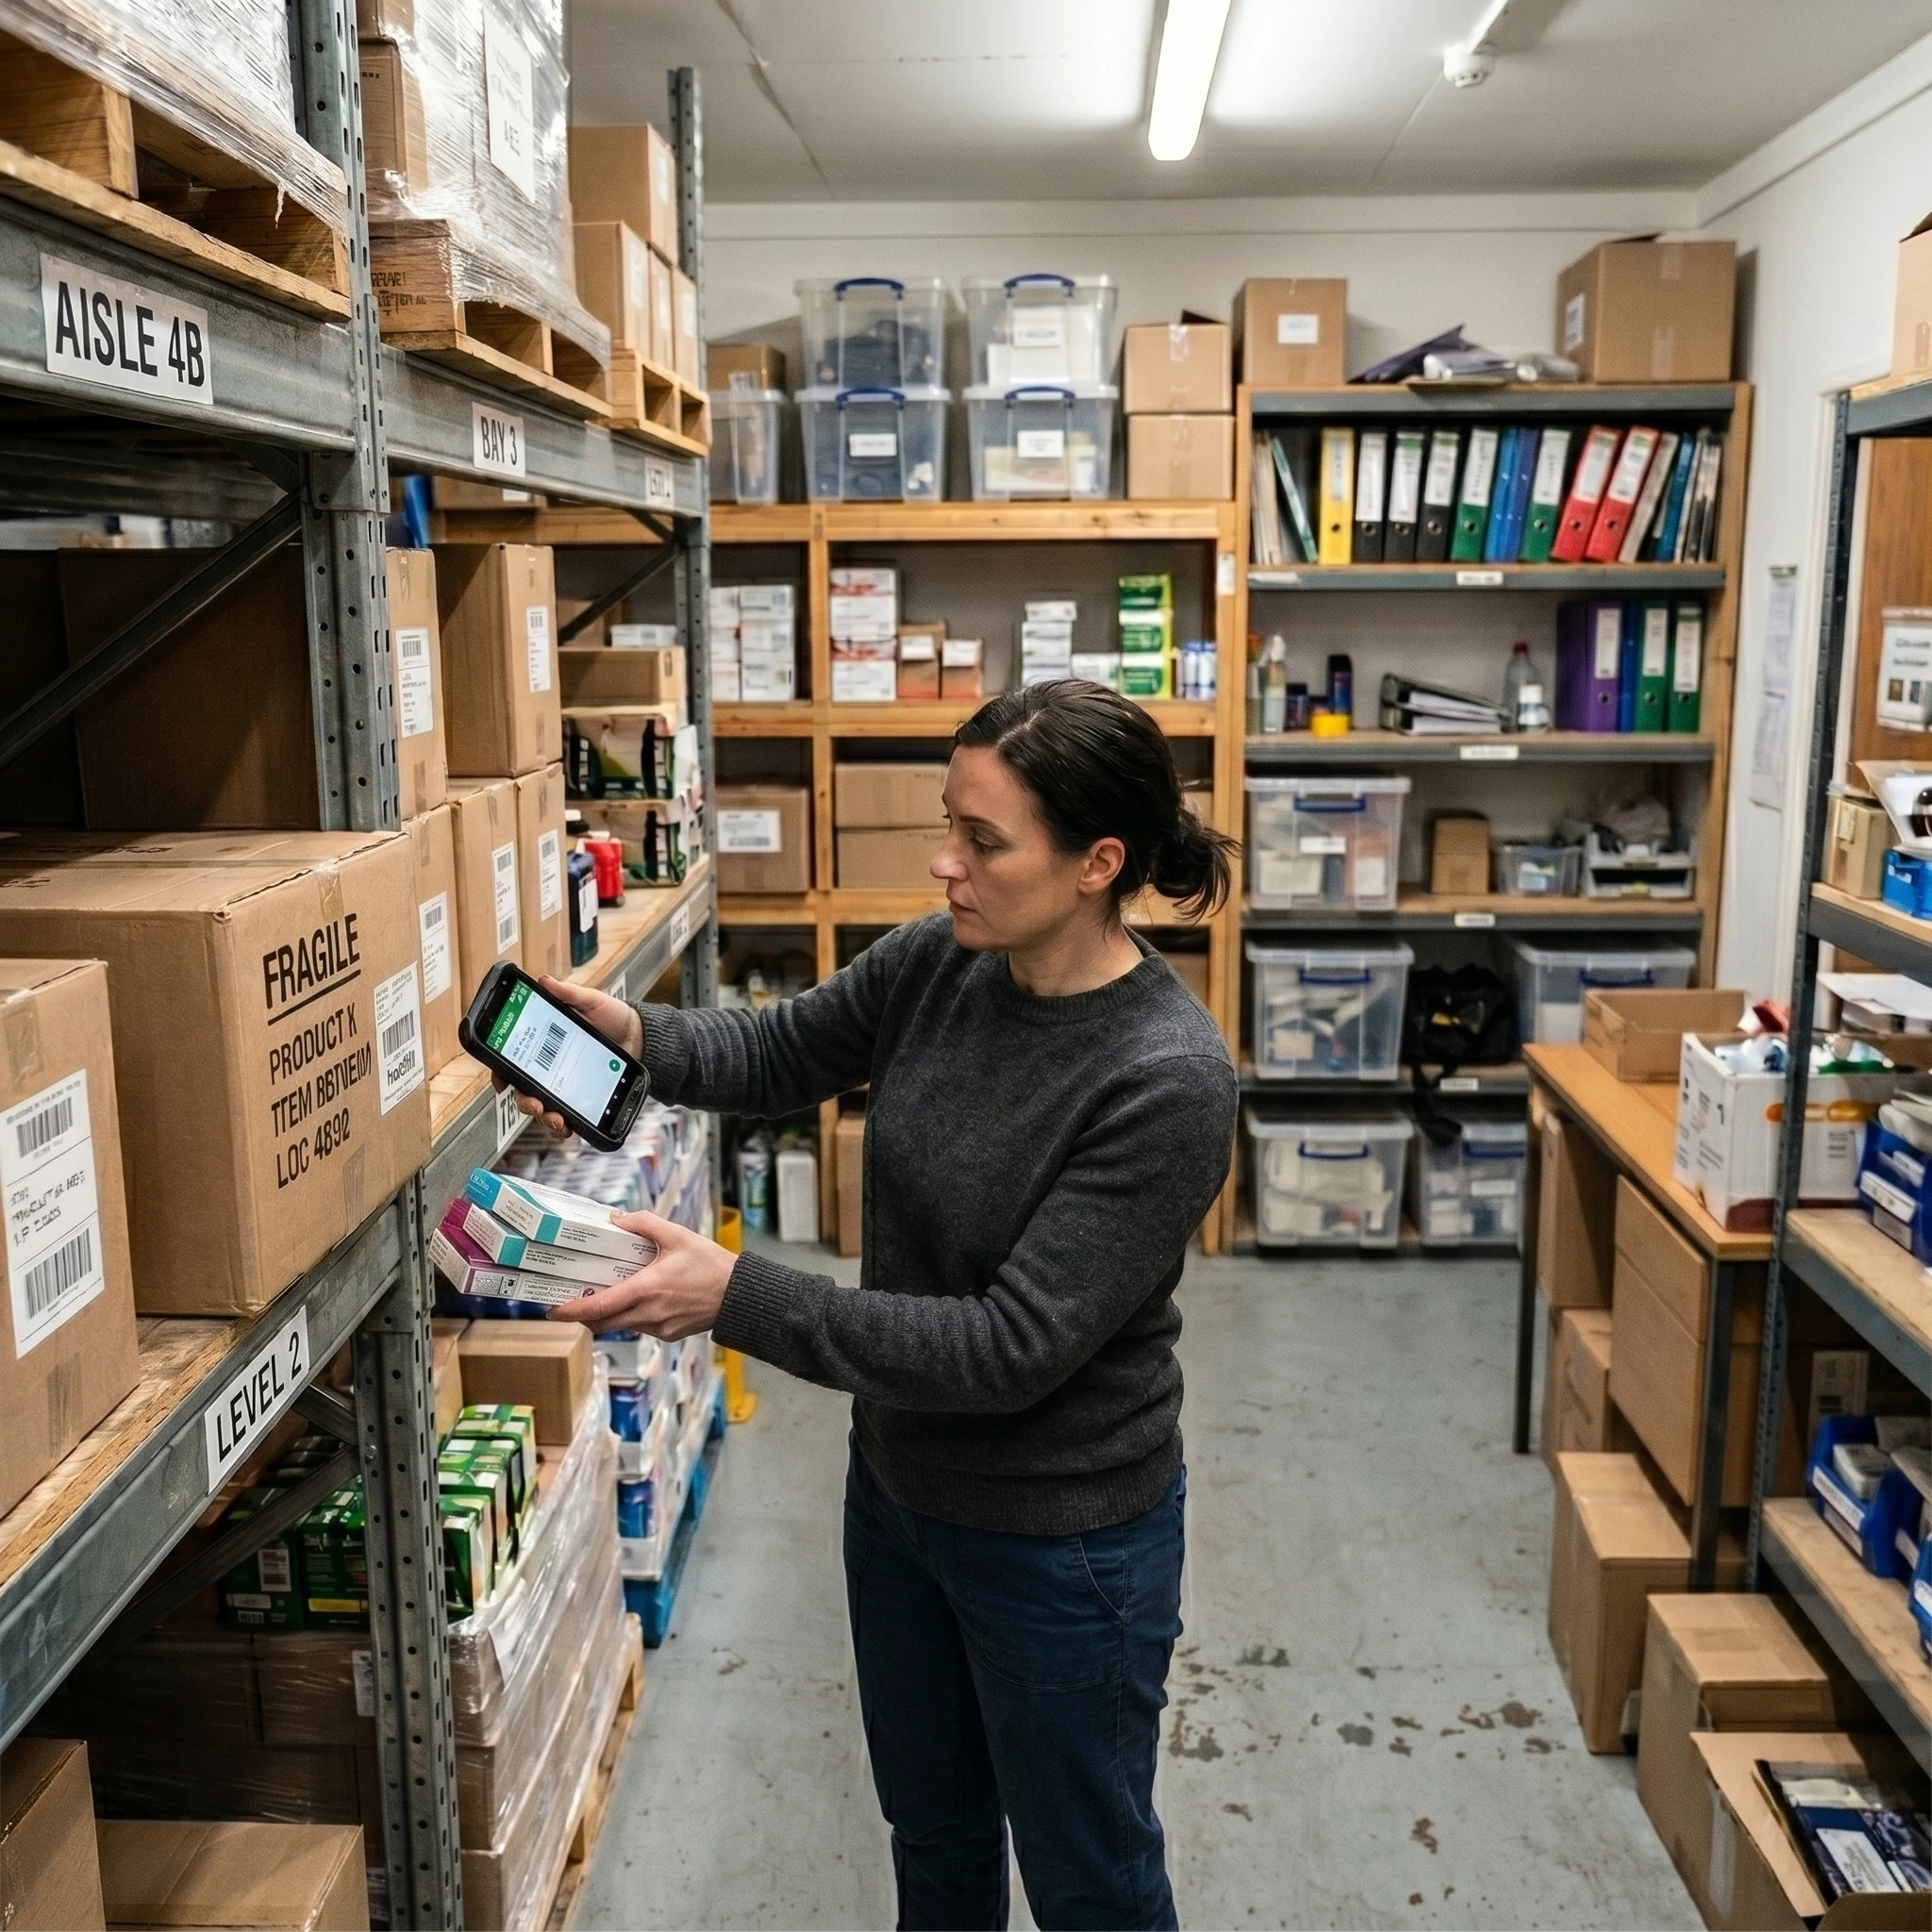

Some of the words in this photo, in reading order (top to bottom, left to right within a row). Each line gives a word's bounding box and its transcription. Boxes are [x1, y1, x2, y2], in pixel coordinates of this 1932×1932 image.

[55, 280, 158, 377] AISLE
[168, 316, 206, 388] 4B
[480, 415, 506, 464] BAY
[509, 425, 518, 466] 3
[262, 912, 360, 1010] FRAGILE
[269, 1008, 344, 1086] PRODUCT
[346, 1002, 358, 1039] K
[276, 1136, 309, 1190] LOC
[313, 1107, 350, 1160] 4892
[216, 1354, 285, 1464] LEVEL
[288, 1331, 302, 1381] 2
